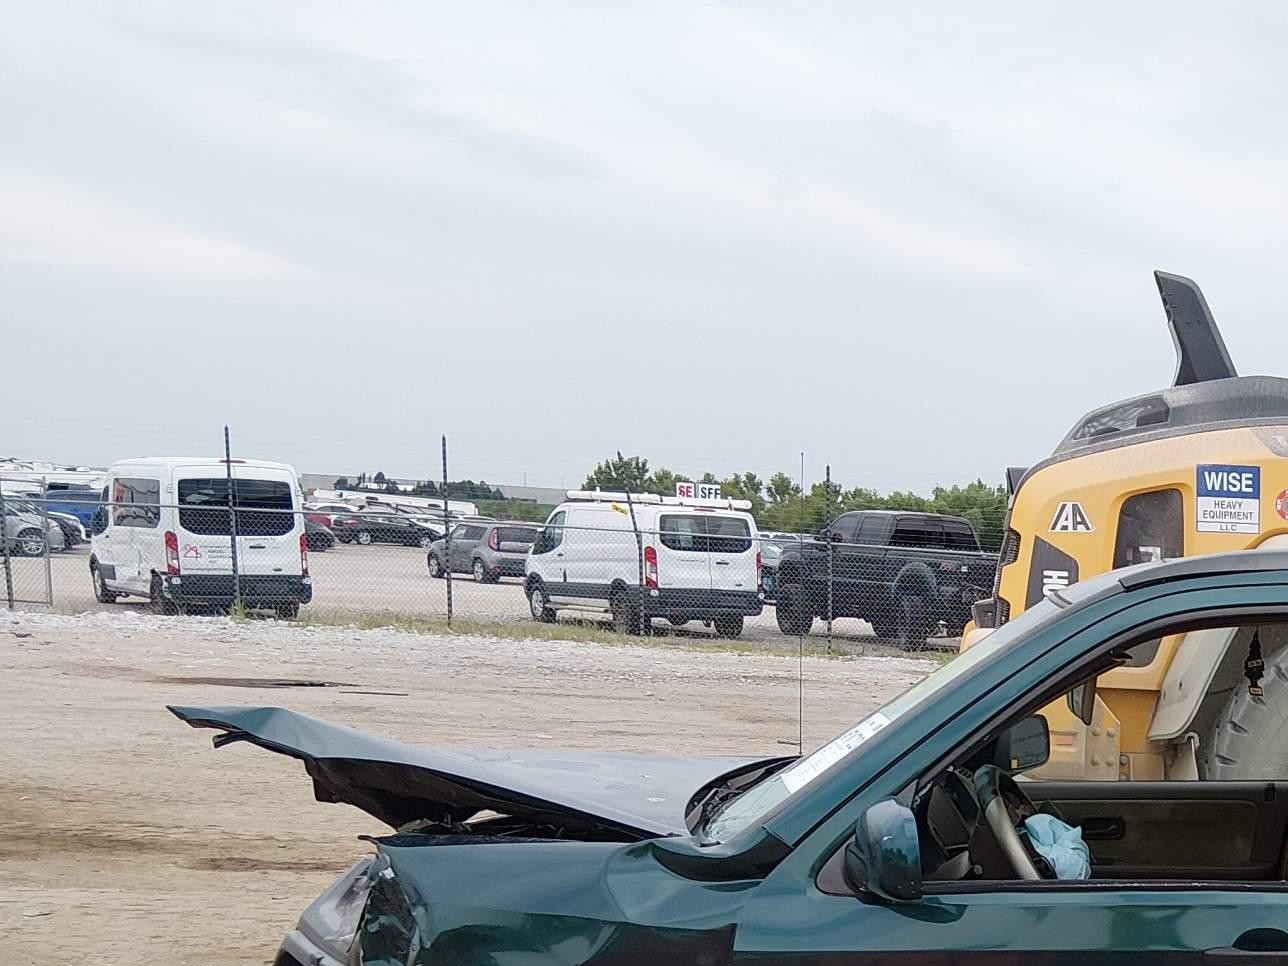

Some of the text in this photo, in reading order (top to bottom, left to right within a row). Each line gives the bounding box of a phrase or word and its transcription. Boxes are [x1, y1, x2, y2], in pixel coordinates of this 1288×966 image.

[1204, 471, 1254, 493] WISE
[1214, 500, 1243, 510] HEAVY
[1202, 510, 1254, 521] EQUIPMENT
[1220, 524, 1237, 532] LLC
